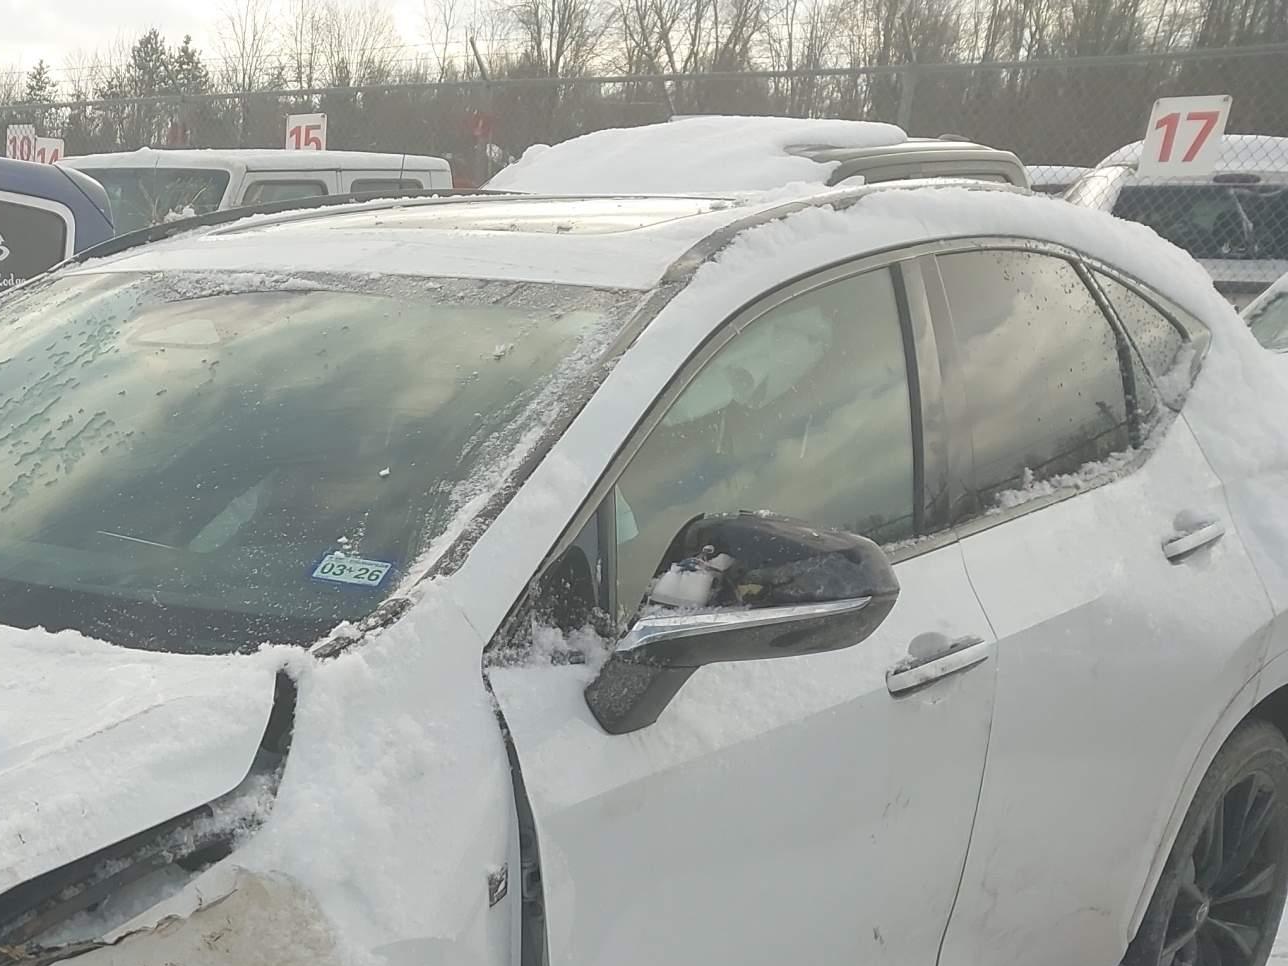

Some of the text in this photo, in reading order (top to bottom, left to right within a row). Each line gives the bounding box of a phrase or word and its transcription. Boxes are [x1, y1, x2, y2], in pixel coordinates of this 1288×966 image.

[9, 136, 31, 161] 10
[289, 125, 321, 150] 15
[1155, 111, 1220, 163] 17
